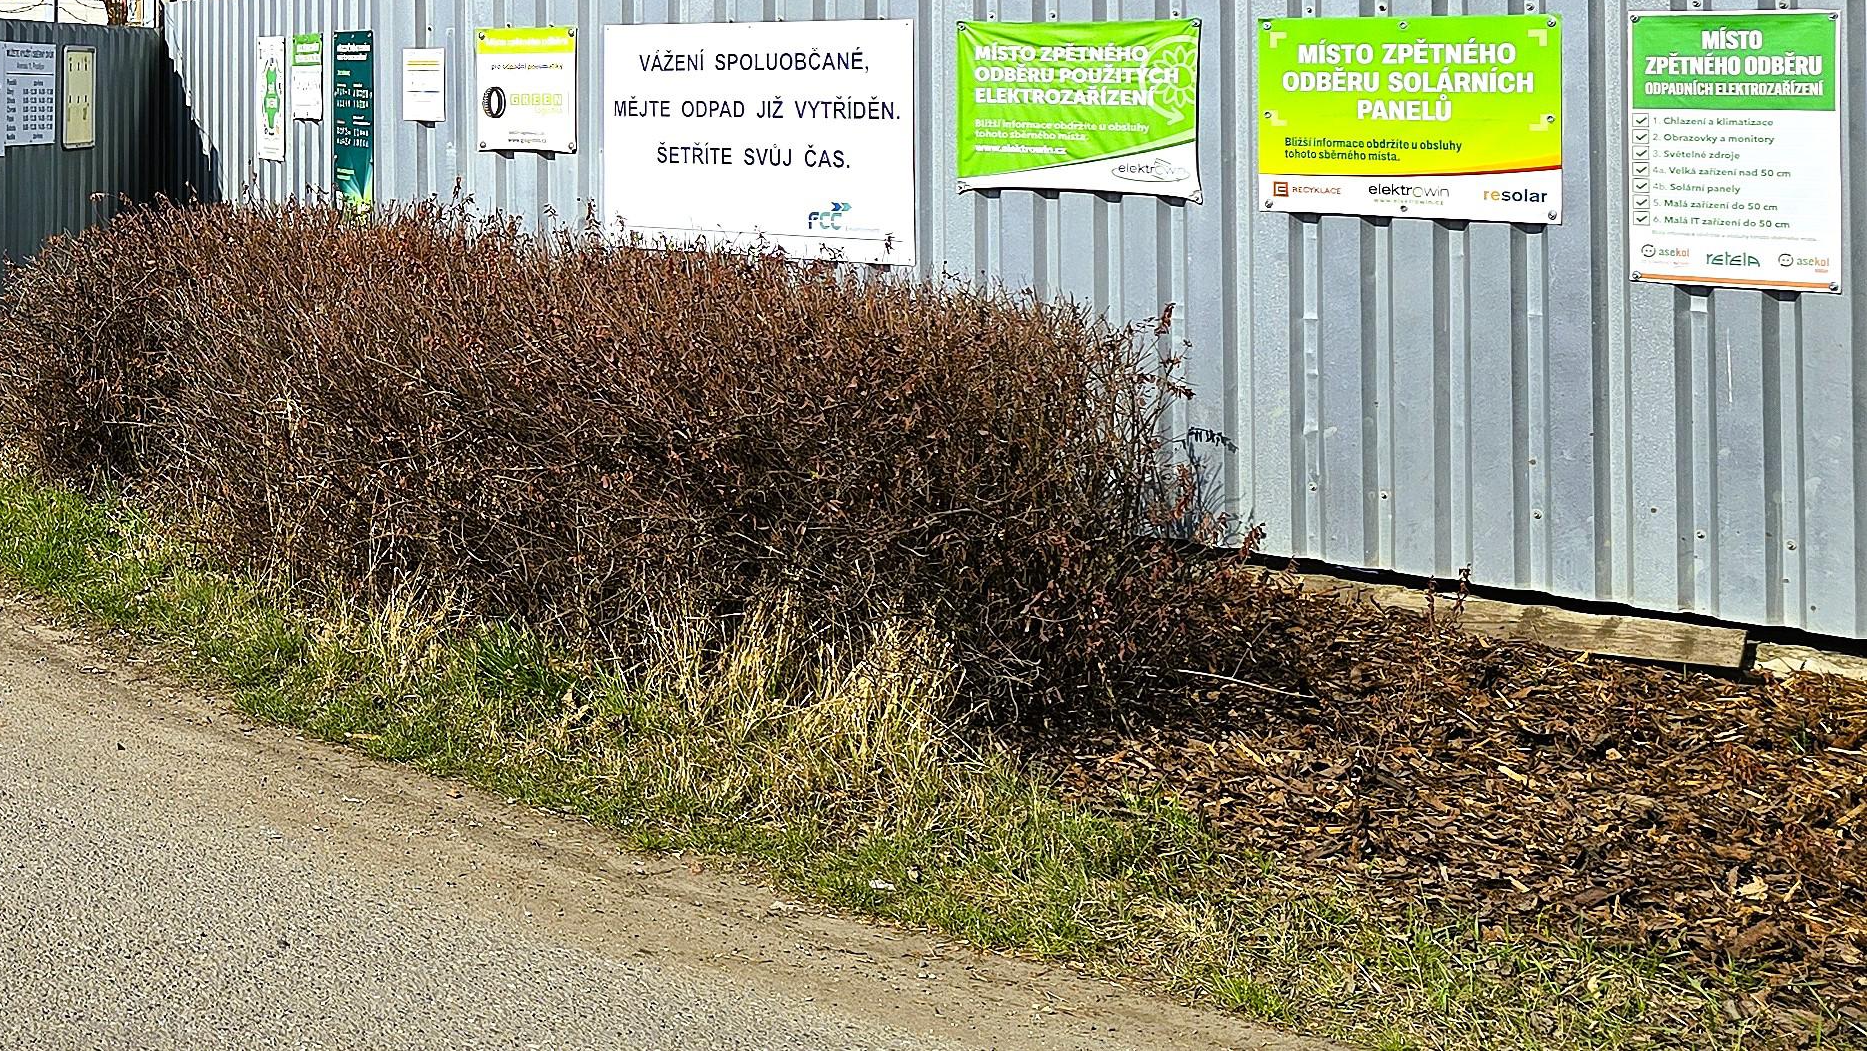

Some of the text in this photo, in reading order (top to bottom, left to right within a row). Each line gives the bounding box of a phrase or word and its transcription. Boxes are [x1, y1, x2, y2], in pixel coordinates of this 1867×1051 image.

[1701, 26, 1763, 50] MÍSTO
[975, 42, 1148, 62] MÍSTO ZPĚTNÉHO
[1297, 38, 1516, 64] MÍSTO ZPĚTNÉHO
[639, 47, 869, 73] VÁŽENÍ SPOLUOBČANÉ,
[1644, 52, 1823, 76] ZPĚTNÉHO ODBĚRU
[974, 64, 1179, 84] ODBĚRU POUŽITÝCH
[1282, 66, 1534, 93] ODBĚRU SOLÁRNÍCH
[1645, 79, 1824, 96] ODPADNÍCH ELEKTROZAŘÍZENÍ
[510, 94, 562, 105] GREEN
[975, 86, 1154, 106] ELEKTROZAŘÍZENÍ
[614, 96, 900, 120] MĚJTE ODPAD JIŽ VYTŘÍDĚN.
[1357, 94, 1452, 121] PANELŮ
[1003, 120, 1053, 130] informace
[1108, 124, 1150, 134] obsluhy
[1663, 117, 1706, 125] Chlazení
[1716, 118, 1774, 126] klimatizace
[975, 130, 1008, 138] tohoto
[1663, 134, 1717, 144] Obrazovky
[1728, 135, 1775, 145] monitory
[1285, 137, 1312, 147] Bližší
[1313, 138, 1364, 148] informace
[1367, 138, 1409, 149] obdržíte
[1419, 140, 1462, 153] obsluhy
[657, 141, 850, 168] ŠETŘÍTE SVŮJ ČAS.
[1285, 149, 1400, 162] tohoto sběrného místa.
[1663, 150, 1706, 158] Světelné
[1709, 151, 1740, 161] zdroje
[1669, 166, 1697, 175] Velká
[1698, 168, 1736, 176] zařízení
[1739, 169, 1758, 177] nad
[1761, 169, 1774, 177] 50
[1292, 186, 1342, 195] RECYKLACE
[1368, 184, 1449, 198] elektrowin
[1484, 188, 1548, 203] resolar
[1670, 183, 1705, 192] Solární
[1707, 185, 1741, 194] panely
[1664, 199, 1688, 208] Malá
[1690, 200, 1729, 209] zařízení
[1731, 202, 1745, 210] do
[1747, 202, 1761, 210] 50
[808, 211, 842, 230] FCC
[1664, 216, 1688, 224] Malá
[1701, 217, 1741, 226] zařízení
[1743, 219, 1756, 227] do
[1759, 219, 1772, 228] 50
[1658, 247, 1690, 257] asekol
[1796, 257, 1830, 267] asekol
